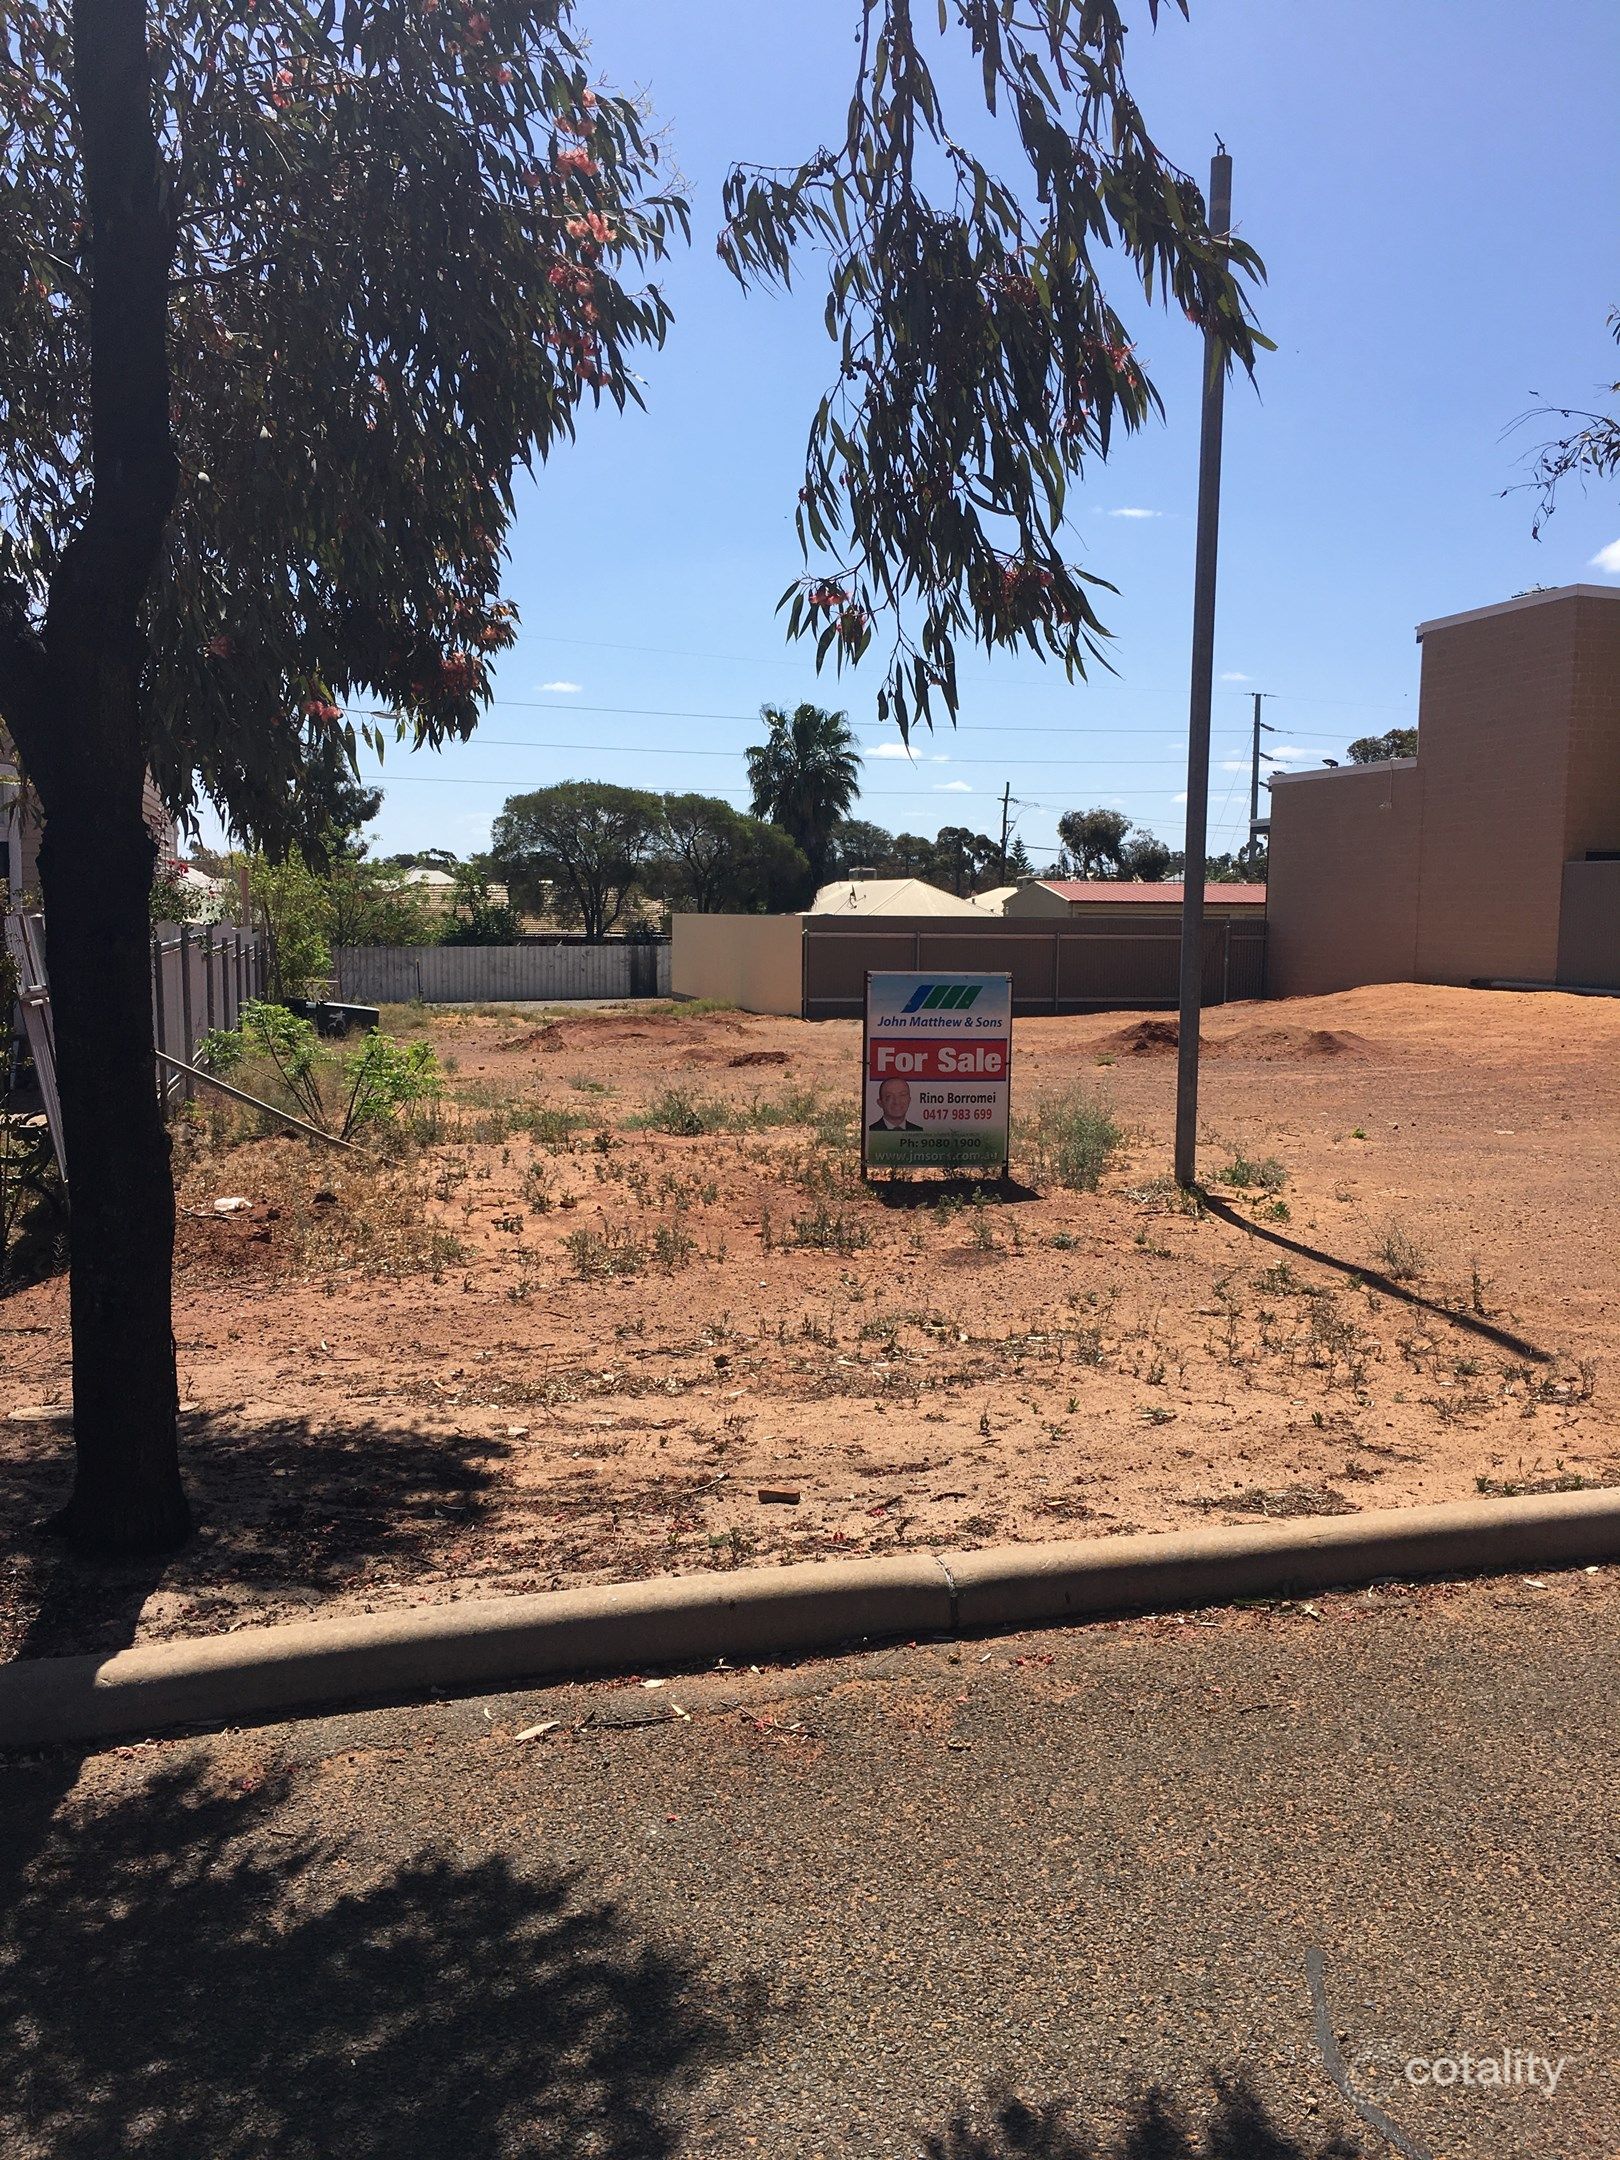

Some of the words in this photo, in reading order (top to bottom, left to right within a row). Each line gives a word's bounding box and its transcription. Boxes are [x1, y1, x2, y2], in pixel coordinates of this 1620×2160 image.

[878, 1016, 906, 1027] John
[909, 1016, 962, 1027] Matthew
[964, 1017, 973, 1027] &
[975, 1017, 1002, 1027] Sons
[877, 1047, 928, 1072] For
[937, 1047, 1001, 1072] Sale
[920, 1092, 944, 1103] Rino
[947, 1092, 996, 1103] Borromei
[923, 1109, 948, 1120] 0417
[952, 1109, 970, 1120] 983
[973, 1109, 992, 1120] 699
[900, 1138, 918, 1148] Ph:
[922, 1138, 950, 1148] 9080
[954, 1138, 981, 1148] 1900
